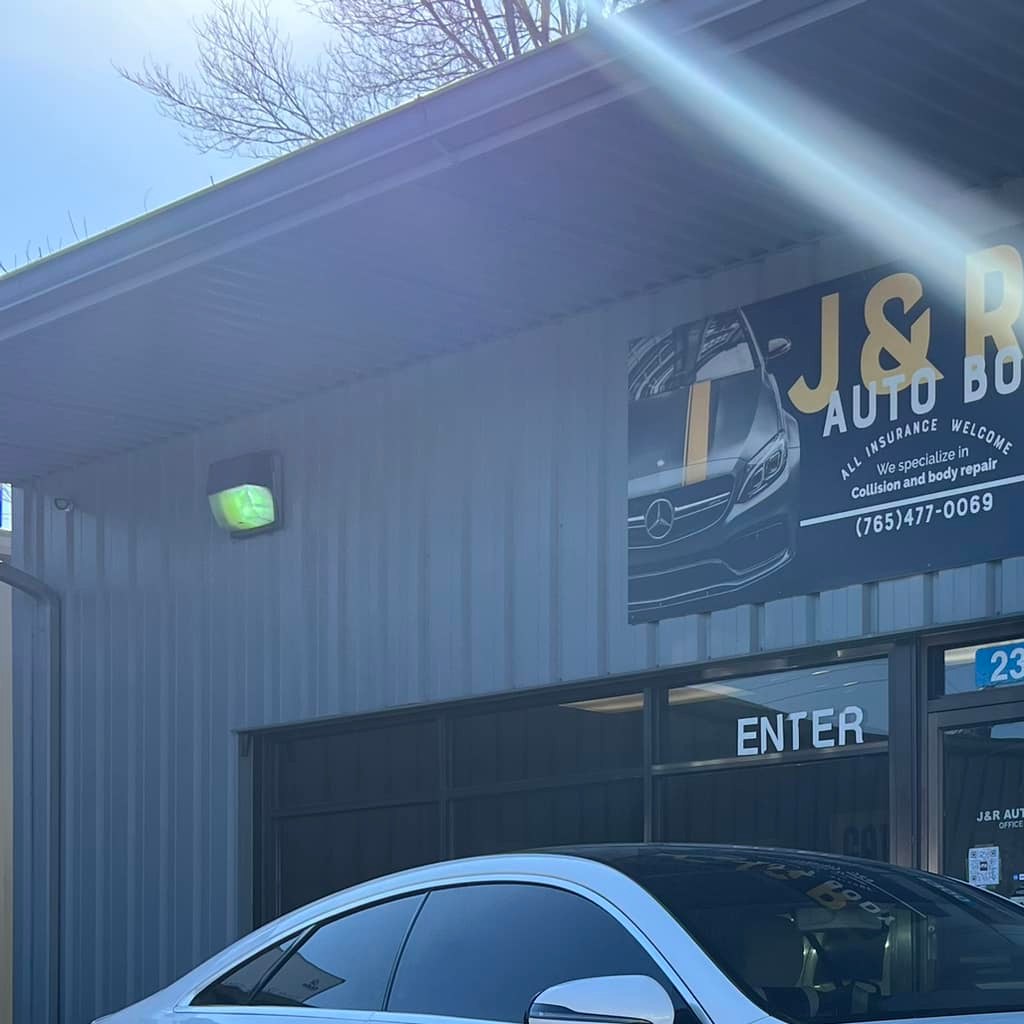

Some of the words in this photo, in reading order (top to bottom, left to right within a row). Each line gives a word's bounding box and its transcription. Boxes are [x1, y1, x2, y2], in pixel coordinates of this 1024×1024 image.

[788, 292, 840, 414] J
[860, 272, 945, 395] &
[965, 244, 1024, 365] R
[822, 367, 937, 437] AUTO
[840, 456, 863, 481] ALL
[865, 418, 938, 458] INSURANCE
[951, 418, 1013, 456] WELCOME
[876, 462, 896, 476] We
[898, 450, 956, 474] specialize
[958, 445, 970, 459] in
[851, 479, 901, 499] Collision
[903, 472, 926, 488] and
[928, 467, 958, 483] body
[960, 457, 998, 477] repair
[855, 492, 994, 538] (765)477-0069
[736, 705, 865, 756] ENTER
[976, 810, 1001, 822] J&R
[998, 820, 1024, 830] OFFICE
